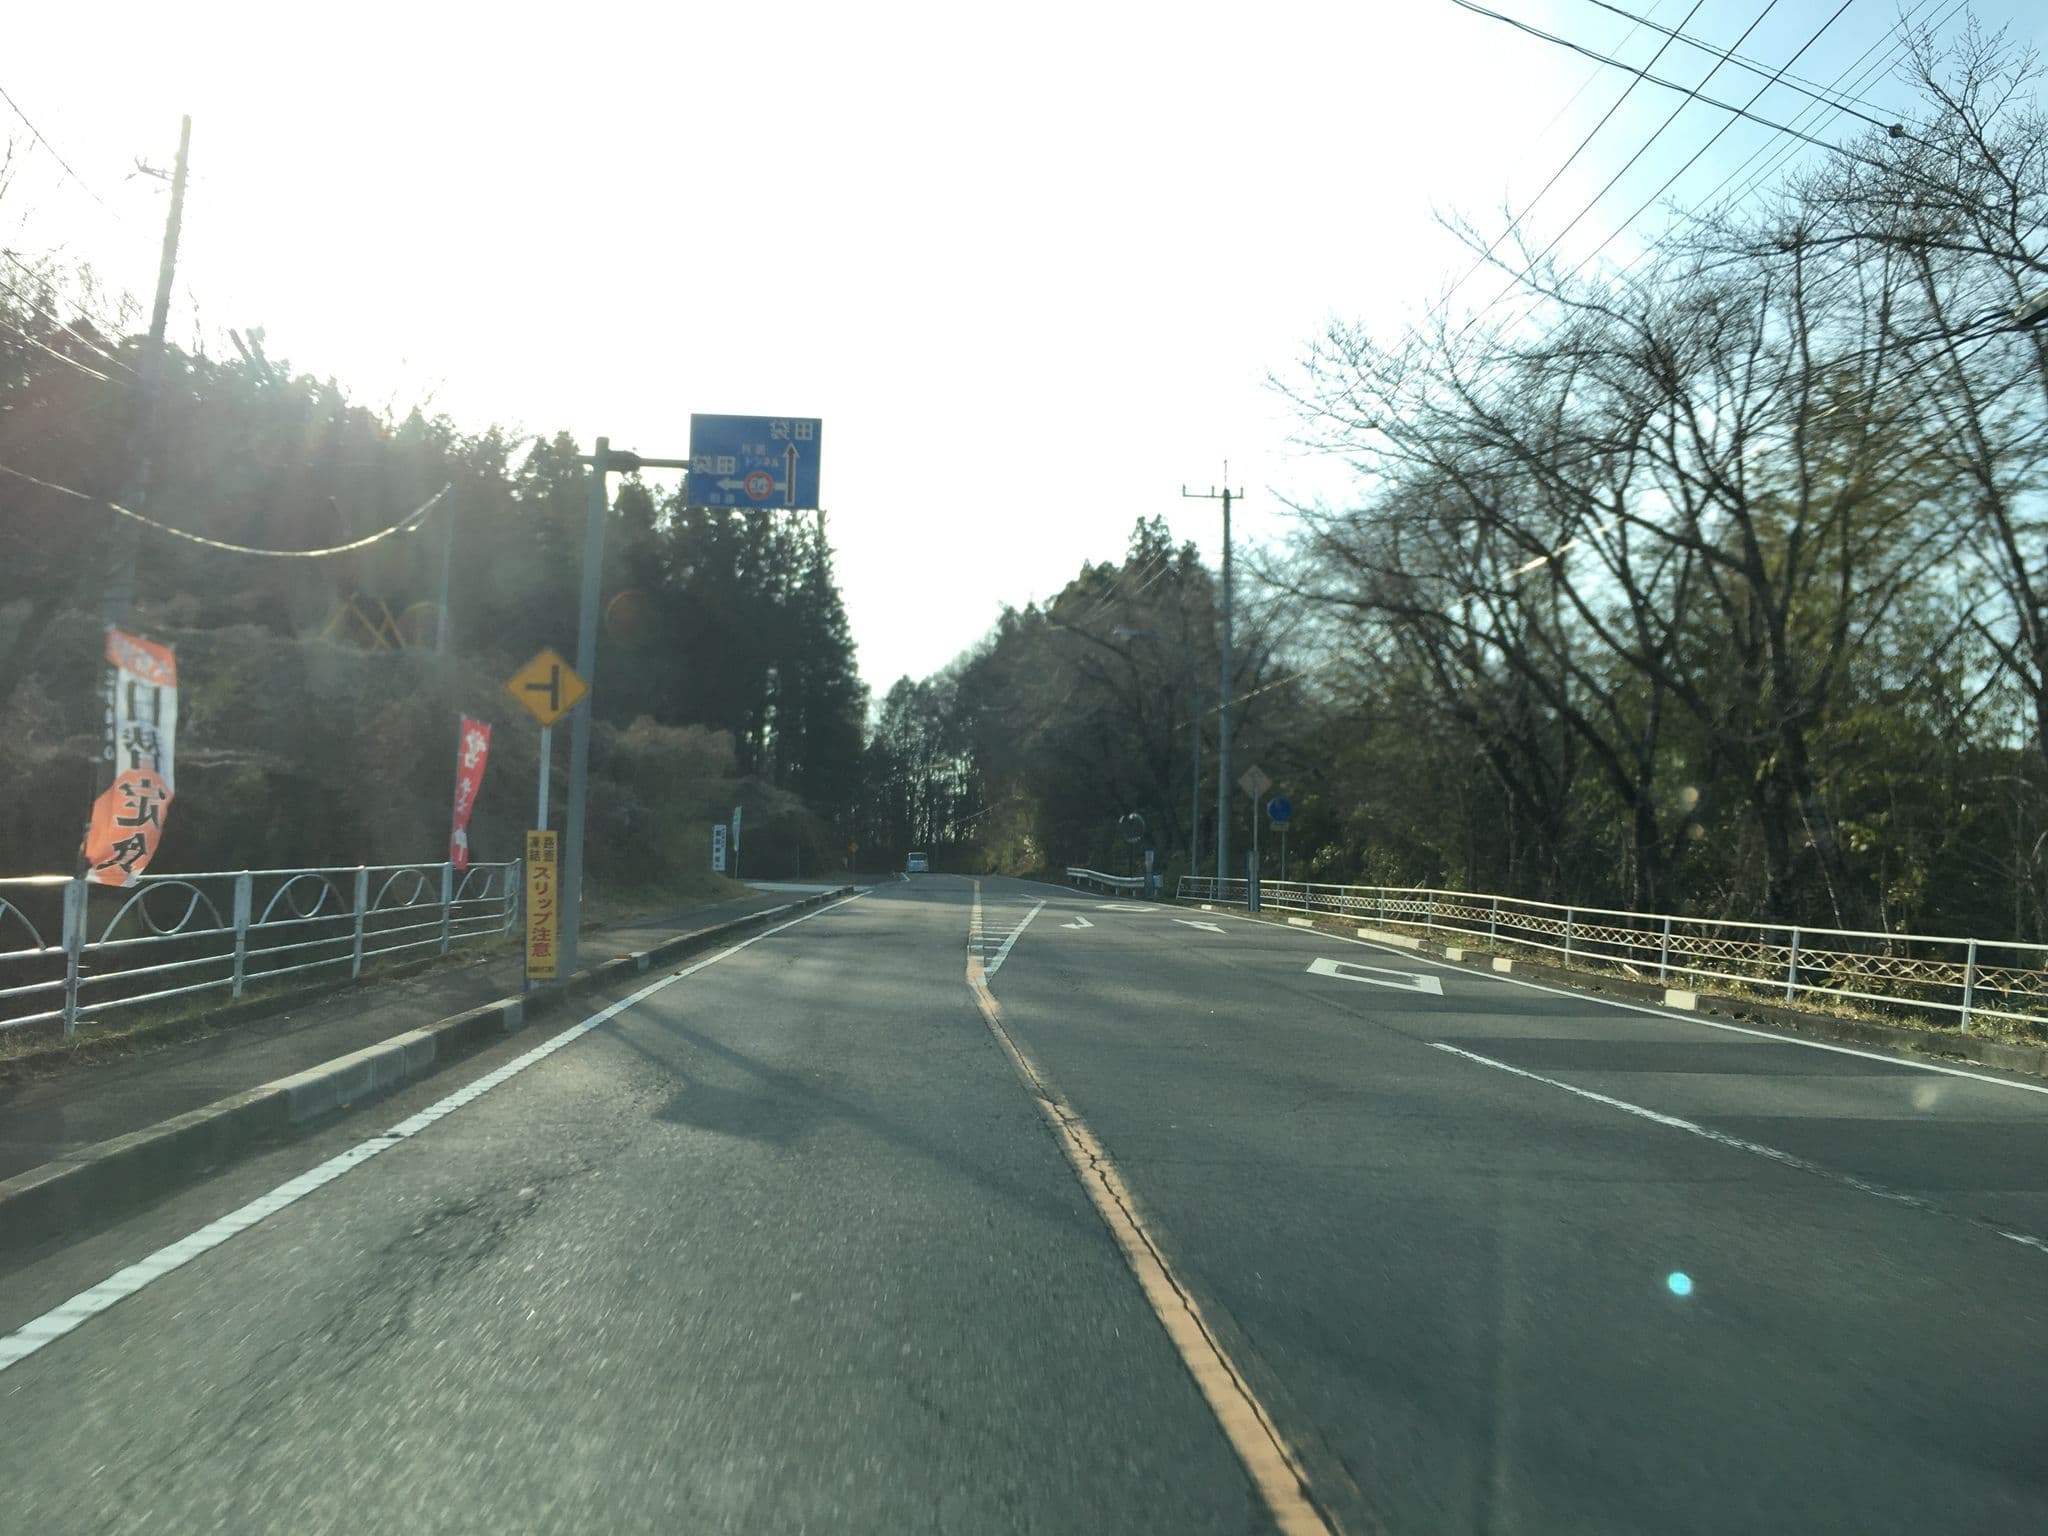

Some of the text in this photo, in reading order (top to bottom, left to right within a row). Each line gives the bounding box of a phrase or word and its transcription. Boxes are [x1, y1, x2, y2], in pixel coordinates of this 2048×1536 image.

[769, 420, 814, 441] 袋田
[691, 455, 736, 475] 袋田
[531, 866, 553, 958] スリップ注意
